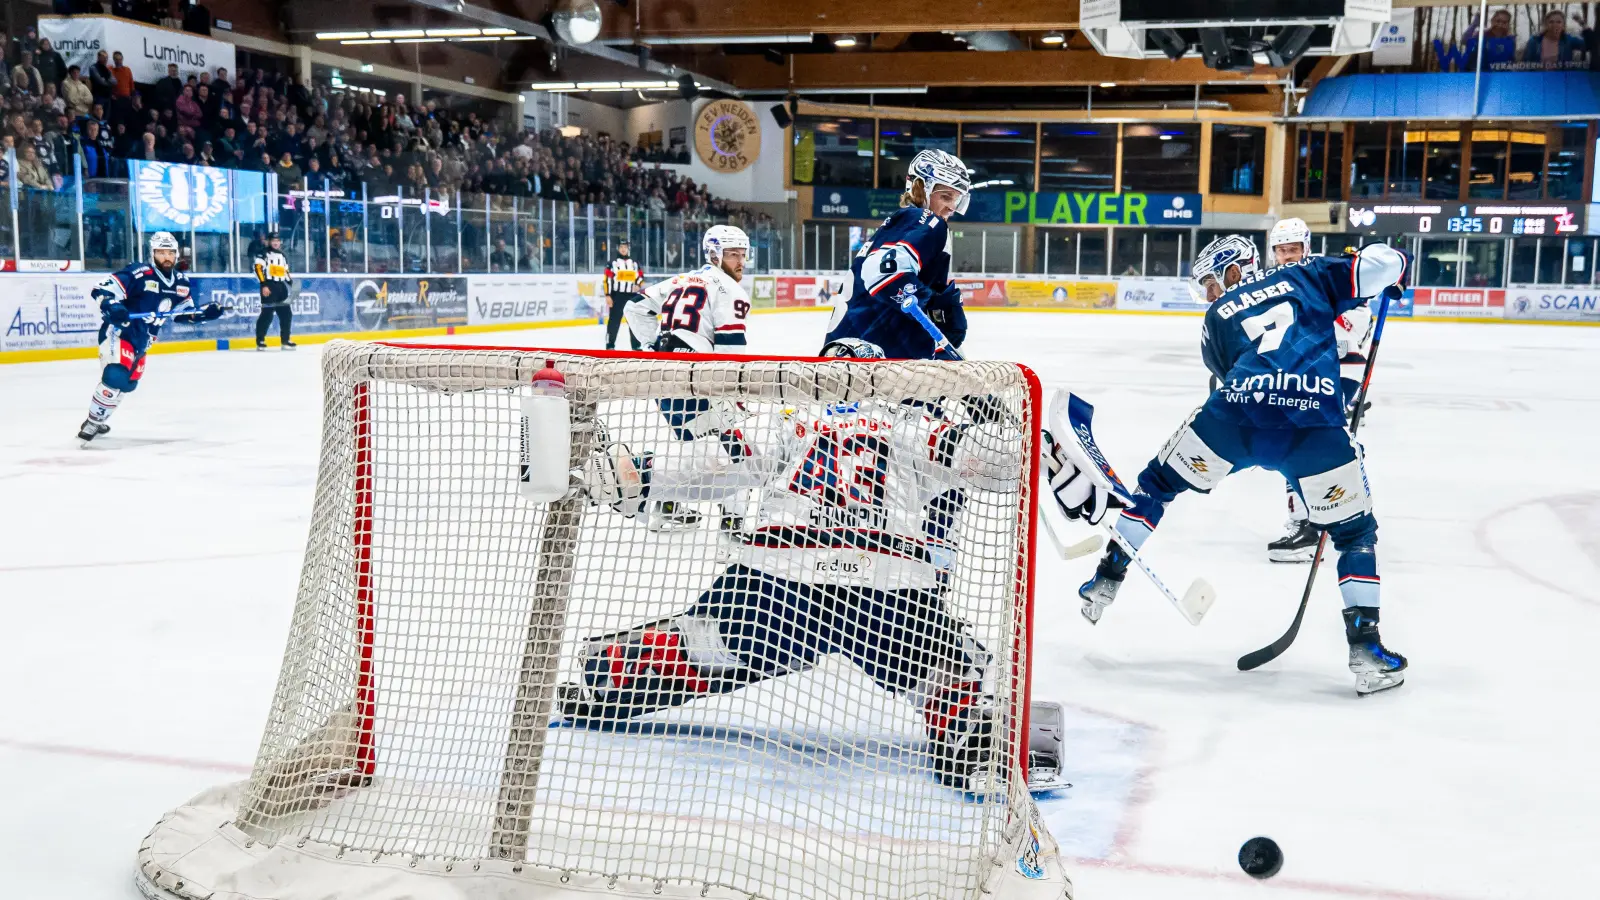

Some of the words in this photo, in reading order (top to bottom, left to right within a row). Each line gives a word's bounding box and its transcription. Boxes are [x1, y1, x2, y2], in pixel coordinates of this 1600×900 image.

[53, 38, 100, 51] uminus
[1380, 36, 1406, 44] BHS
[143, 36, 205, 67] Luminus
[720, 103, 757, 134] WEIDEN
[708, 150, 748, 169] 1985
[821, 204, 849, 214] BHS
[1004, 191, 1148, 225] PLAYER
[1163, 209, 1193, 219] BHS
[1419, 215, 1432, 232] 0
[1447, 217, 1482, 232] 13:25
[1489, 216, 1503, 233] 0
[879, 248, 898, 274] 8
[1216, 280, 1295, 320] GLÄSER
[1437, 291, 1482, 303] MEIER
[1539, 294, 1600, 310] SCAN
[661, 286, 708, 333] 93
[5, 306, 60, 336] Arnold
[1240, 301, 1295, 355] 7
[1226, 391, 1250, 404] Wir
[1267, 393, 1321, 411] Energie
